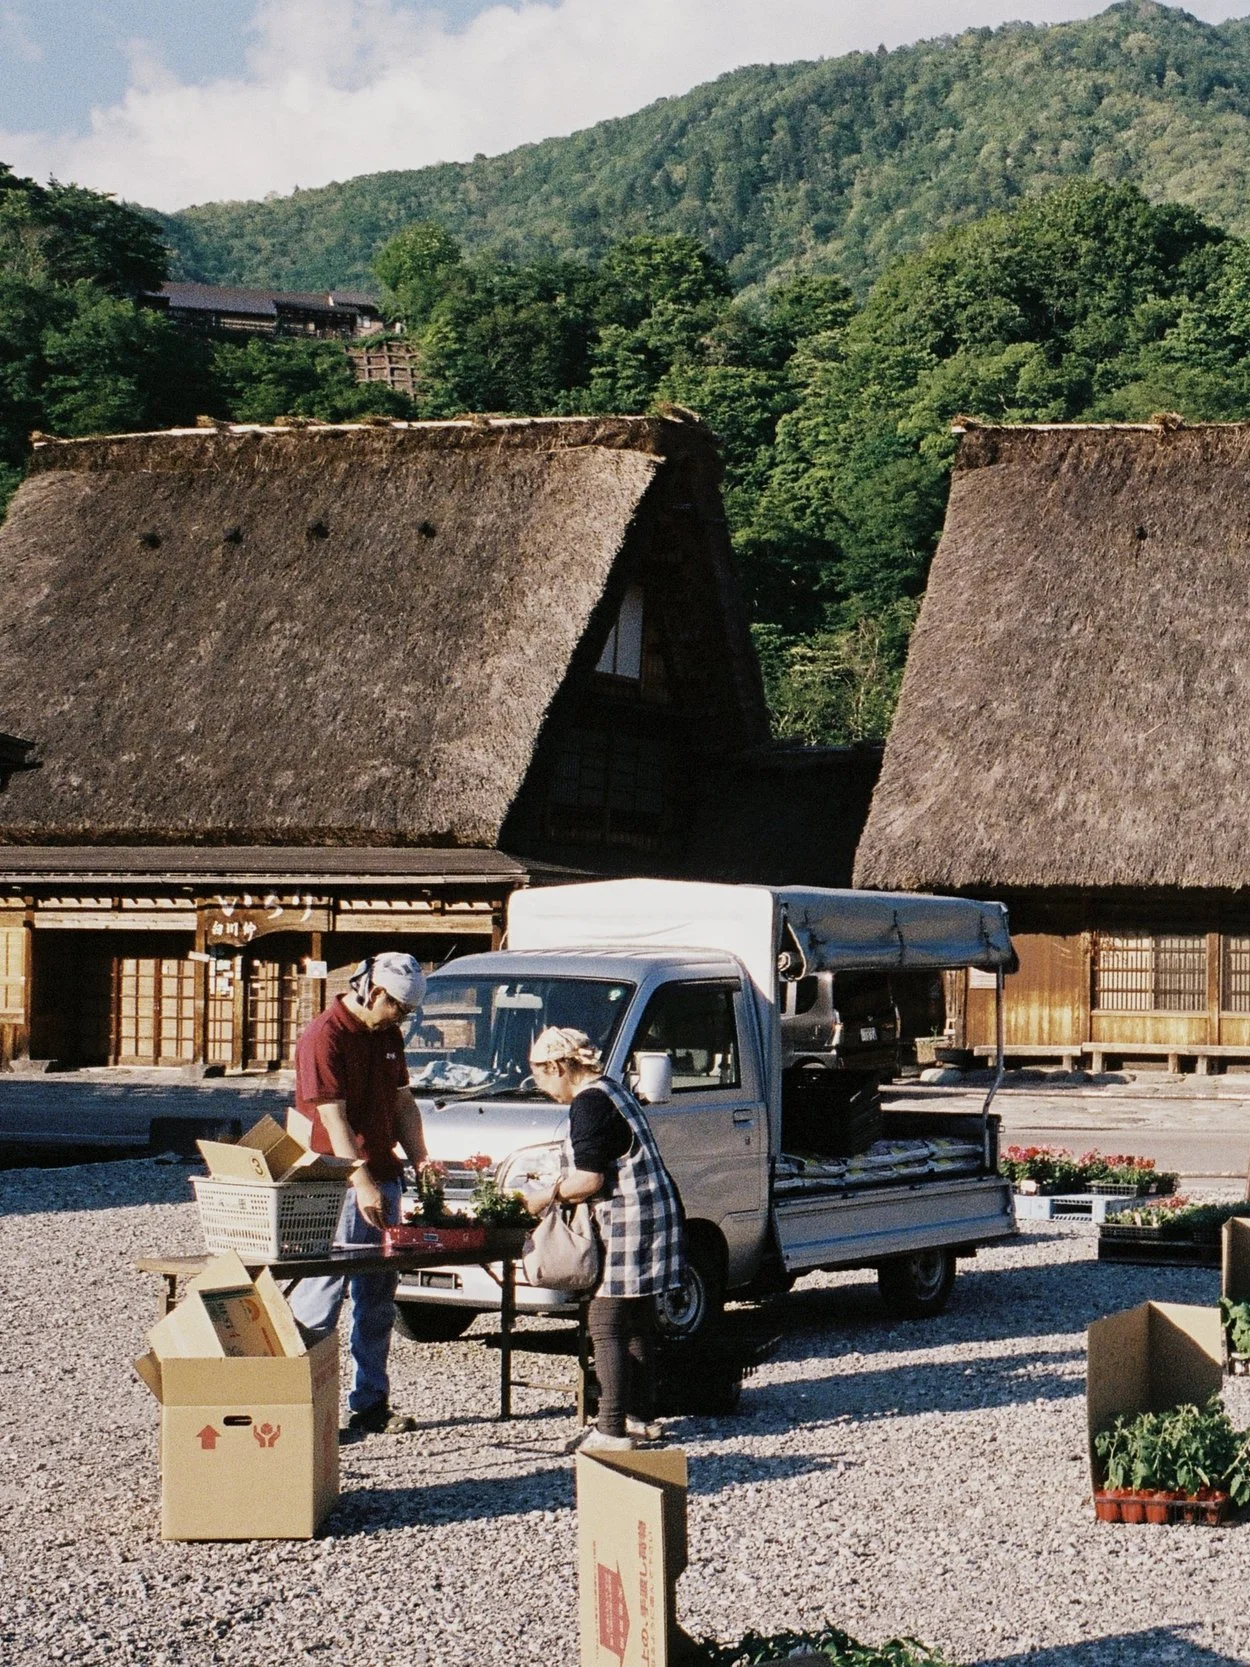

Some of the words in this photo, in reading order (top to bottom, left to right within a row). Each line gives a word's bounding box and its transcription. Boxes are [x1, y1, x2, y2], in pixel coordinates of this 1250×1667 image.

[213, 890, 313, 922] いろり
[251, 1157, 264, 1176] 3
